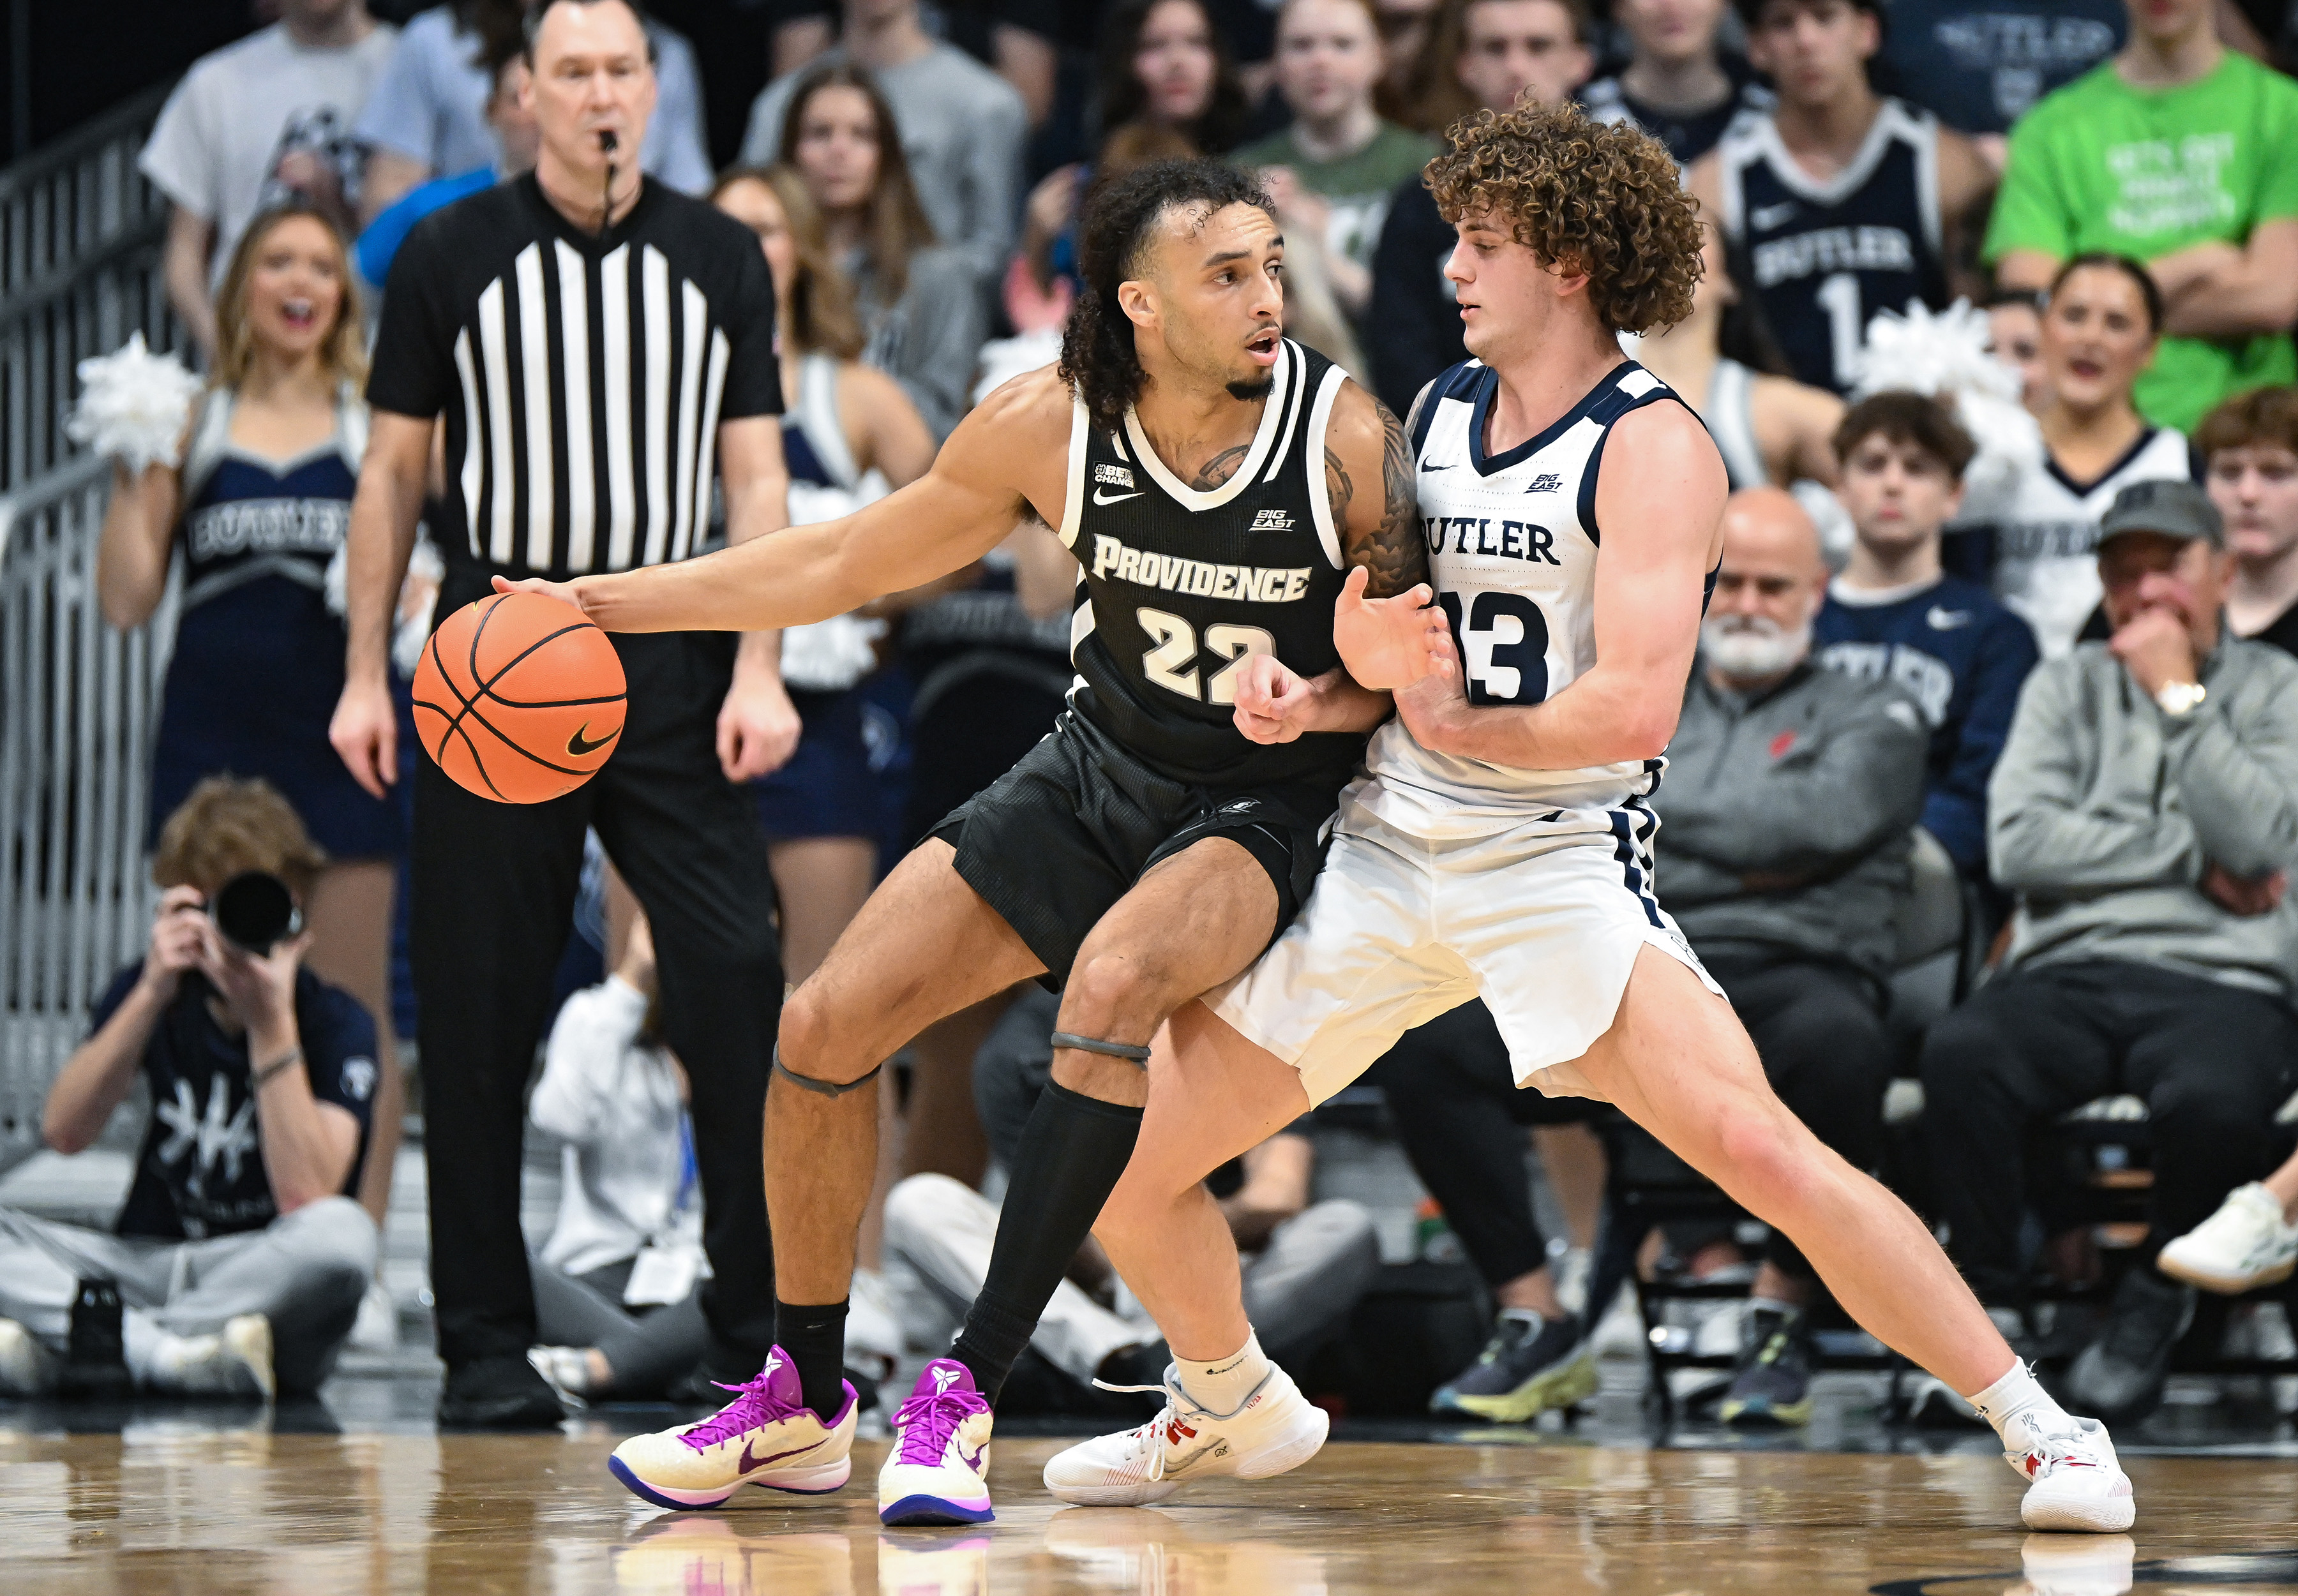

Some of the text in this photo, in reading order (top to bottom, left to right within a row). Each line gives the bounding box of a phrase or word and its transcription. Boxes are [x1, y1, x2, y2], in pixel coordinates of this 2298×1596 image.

[1753, 225, 1914, 287] BUTLER
[1535, 474, 1560, 482] BIG
[1252, 518, 1296, 528] EAST
[1256, 509, 1287, 519] BIG
[1422, 517, 1561, 565] UTLER
[1136, 606, 1277, 706] 22
